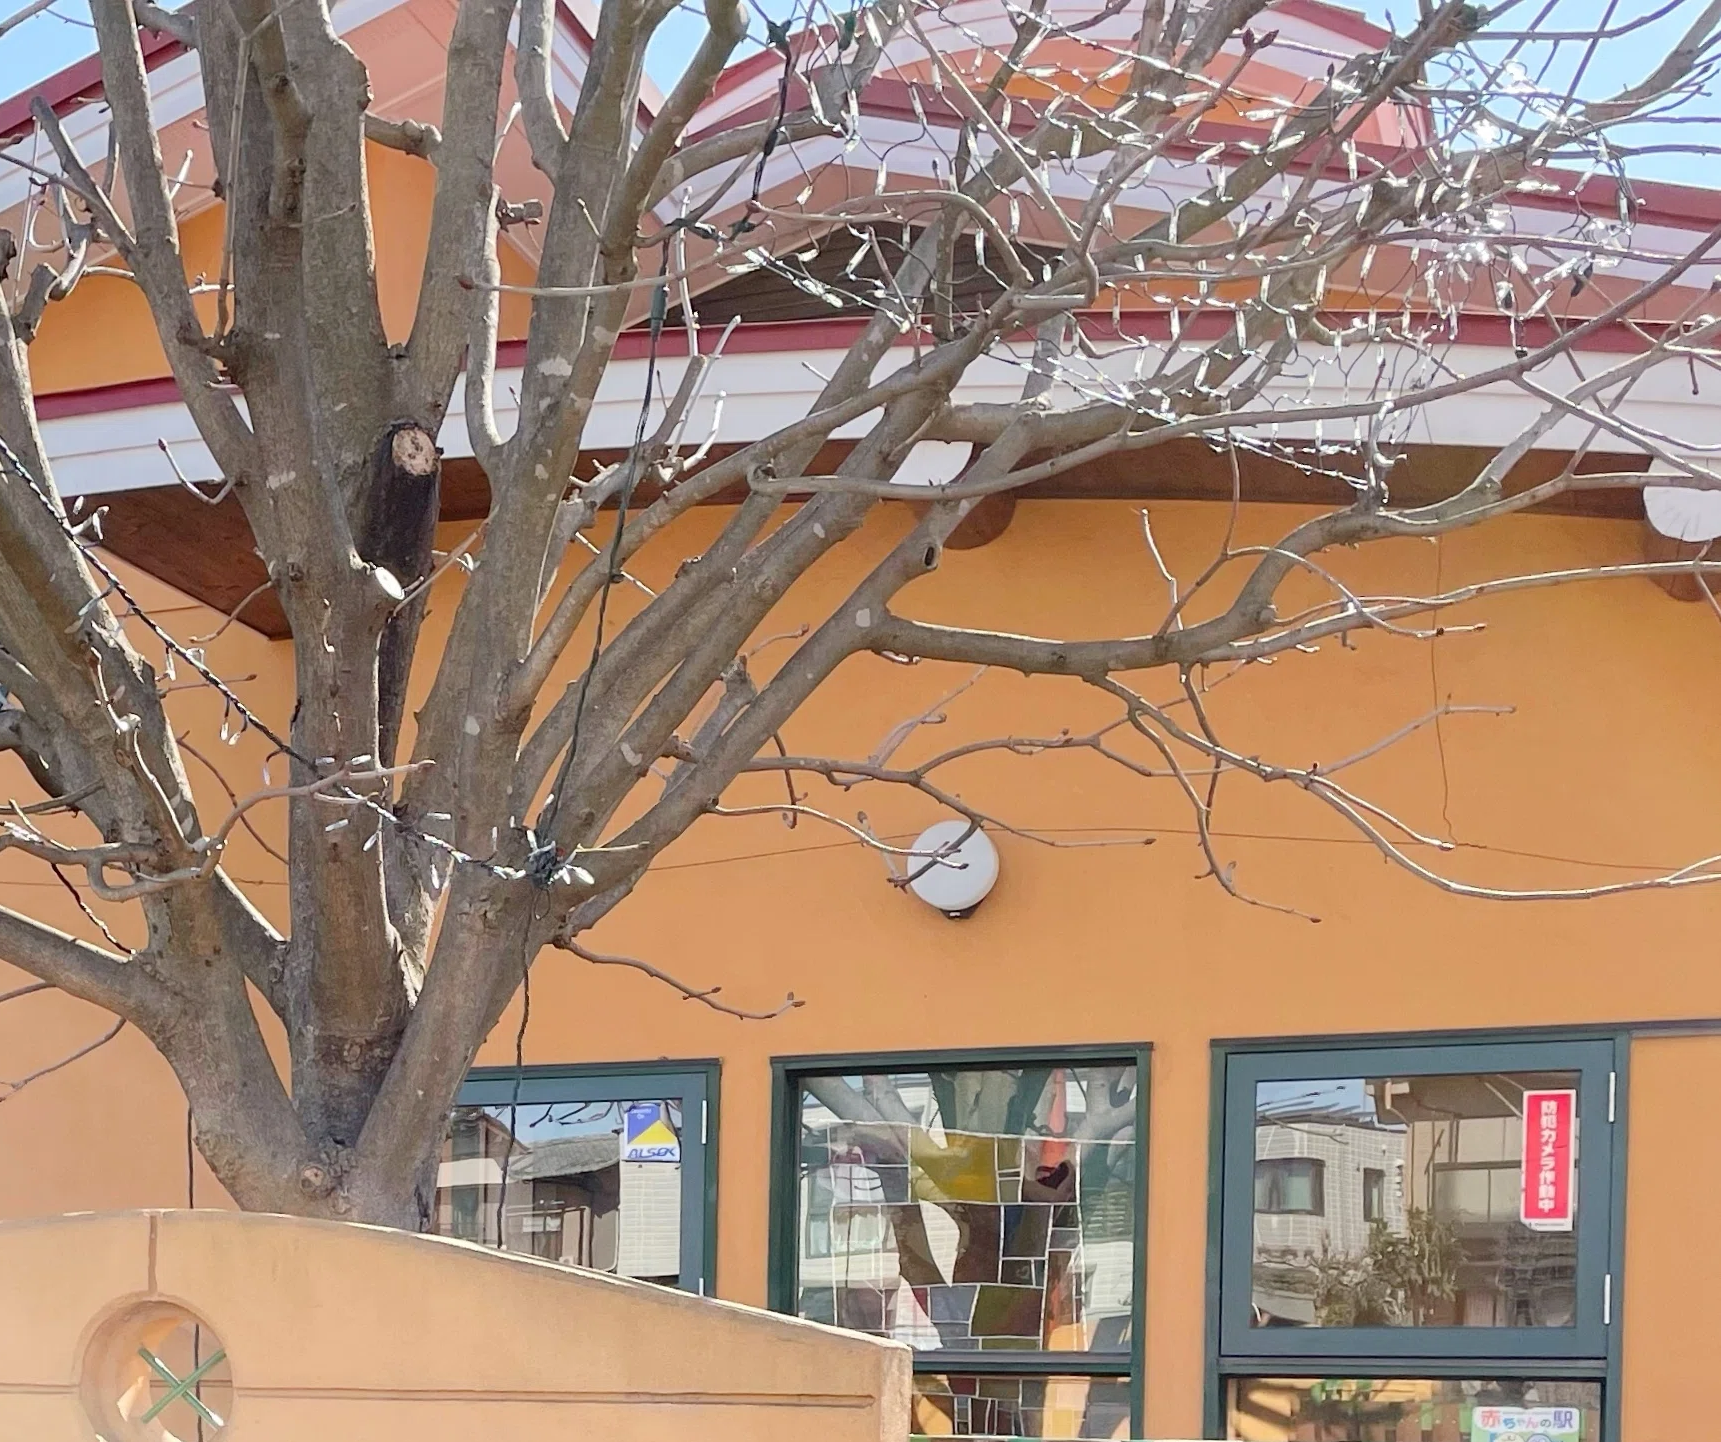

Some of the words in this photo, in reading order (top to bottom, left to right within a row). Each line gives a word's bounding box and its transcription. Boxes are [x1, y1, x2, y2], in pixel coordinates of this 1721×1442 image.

[1481, 1409, 1573, 1430] 赤ちゃんの駅
